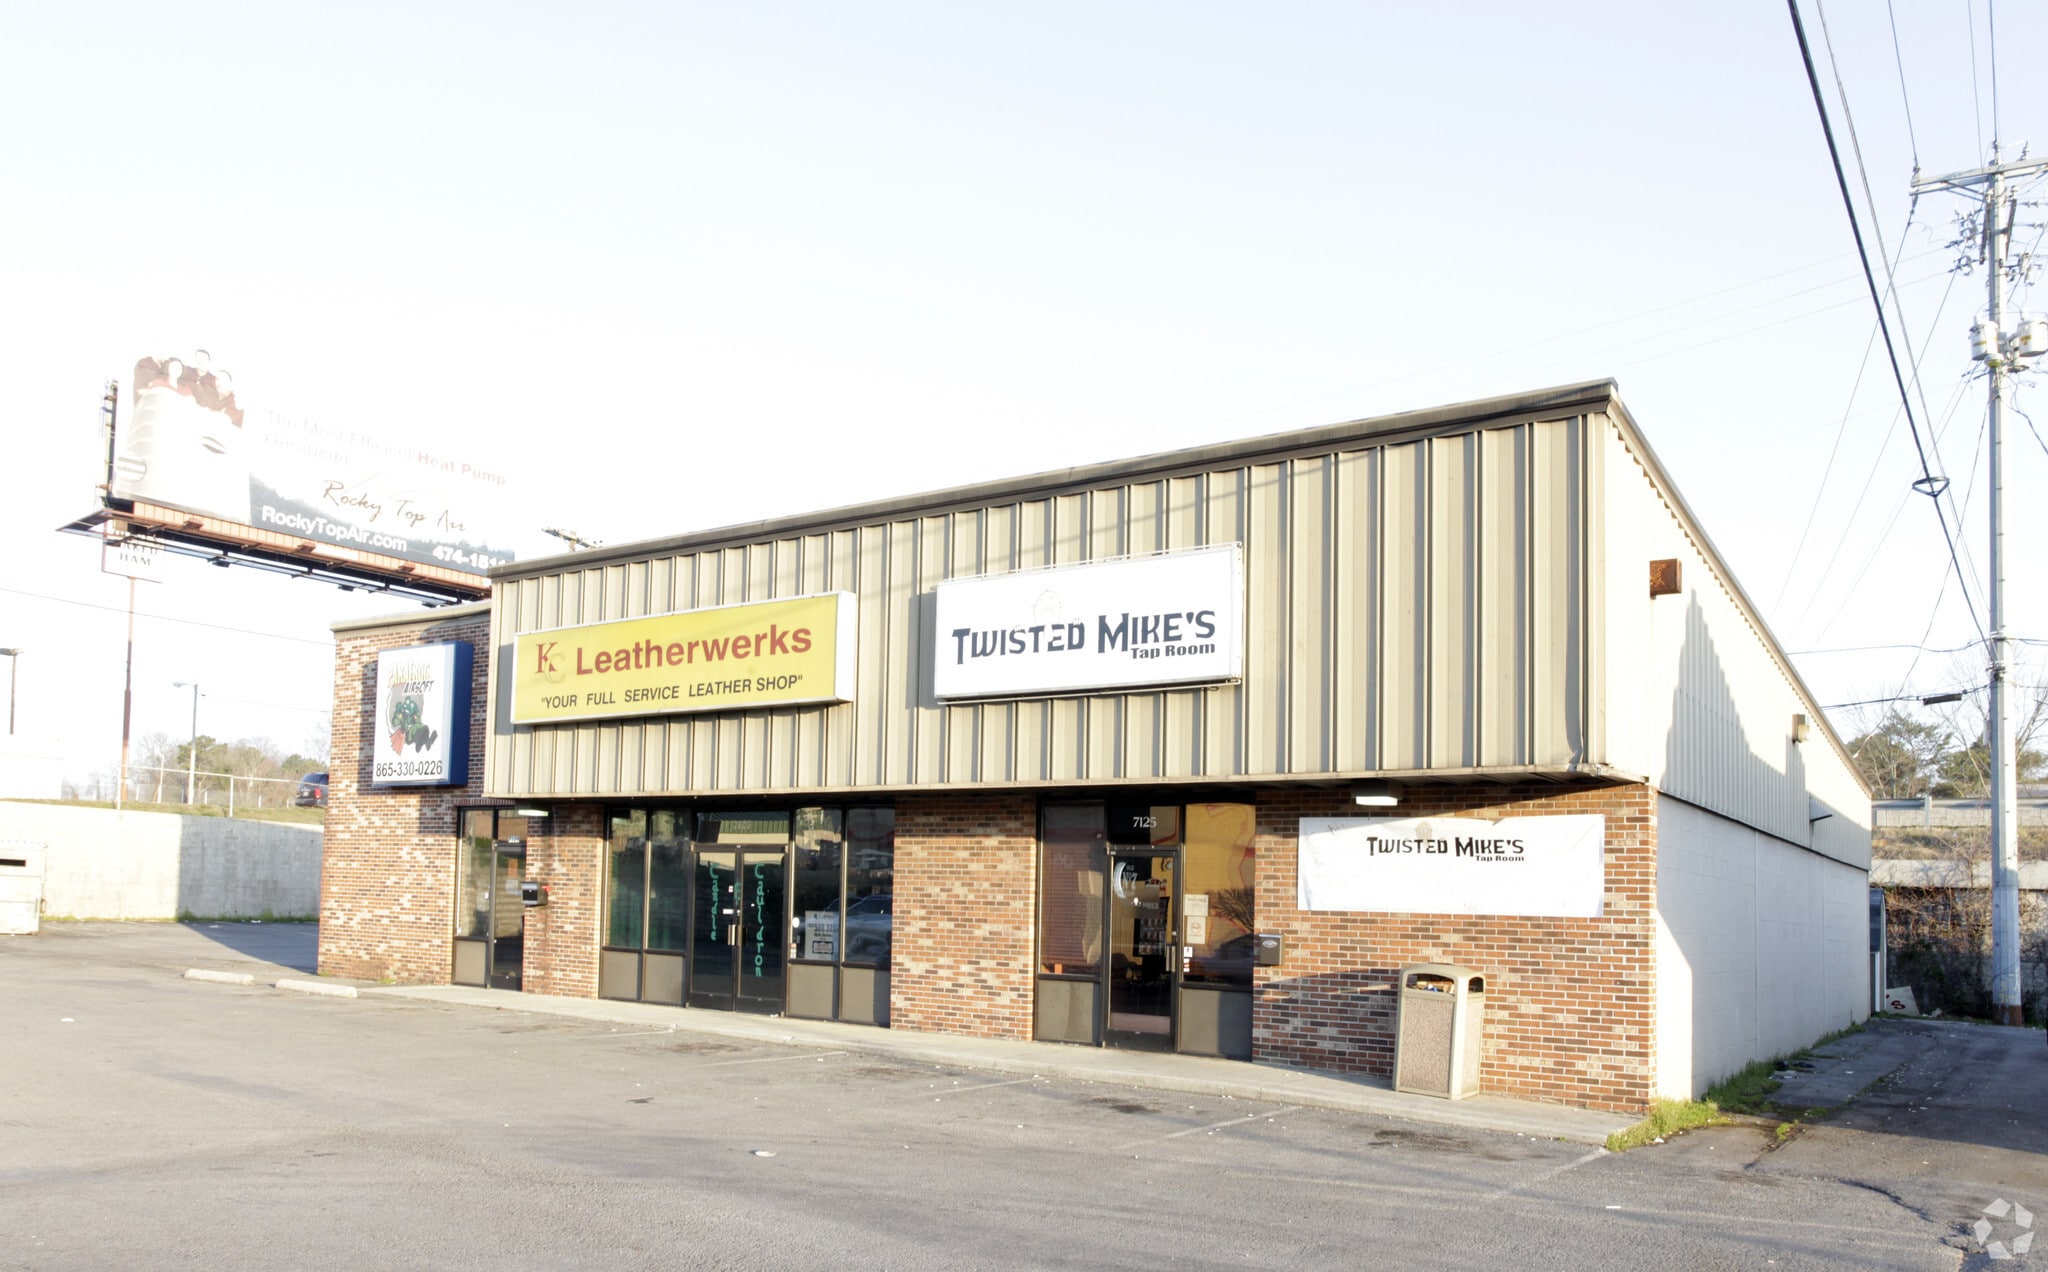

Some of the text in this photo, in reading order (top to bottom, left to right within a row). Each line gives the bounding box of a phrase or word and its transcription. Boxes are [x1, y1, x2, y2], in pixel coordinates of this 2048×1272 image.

[417, 451, 455, 473] Heat
[461, 463, 506, 486] Pump
[323, 480, 383, 522] Rocky
[396, 500, 426, 528] Top
[262, 505, 408, 552] RockyTopAir.com
[120, 552, 151, 566] HAM
[576, 624, 812, 675] Leatherwerks
[952, 610, 1216, 665] TWISTED MIKE'S
[1131, 643, 1215, 659] Tap Room
[586, 692, 616, 706] FULL
[624, 685, 680, 703] SERVICE
[688, 681, 751, 698] LEATHER
[756, 674, 803, 692] SHOP"
[376, 760, 443, 777] 865-330-0226
[1132, 816, 1157, 828] 7125
[1366, 837, 1524, 857] TWISTED MIKE'S
[754, 863, 764, 977] Cauldron
